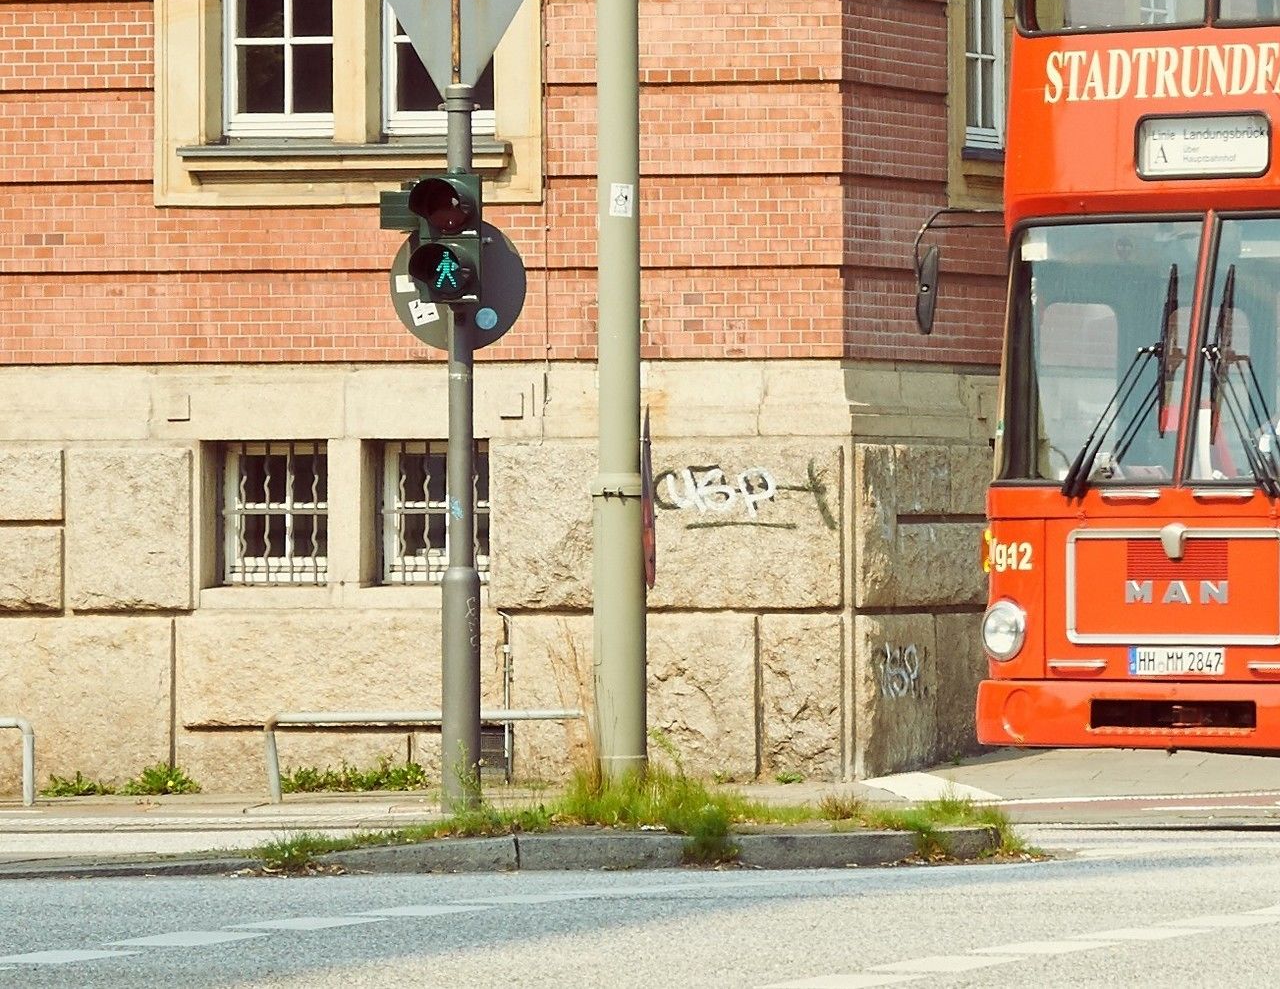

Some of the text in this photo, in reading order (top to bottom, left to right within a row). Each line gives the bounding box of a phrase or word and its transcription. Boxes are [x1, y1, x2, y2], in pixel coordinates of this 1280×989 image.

[1154, 145, 1168, 163] A
[1125, 580, 1229, 605] MAN
[1138, 651, 1222, 672] HH MM 2847
